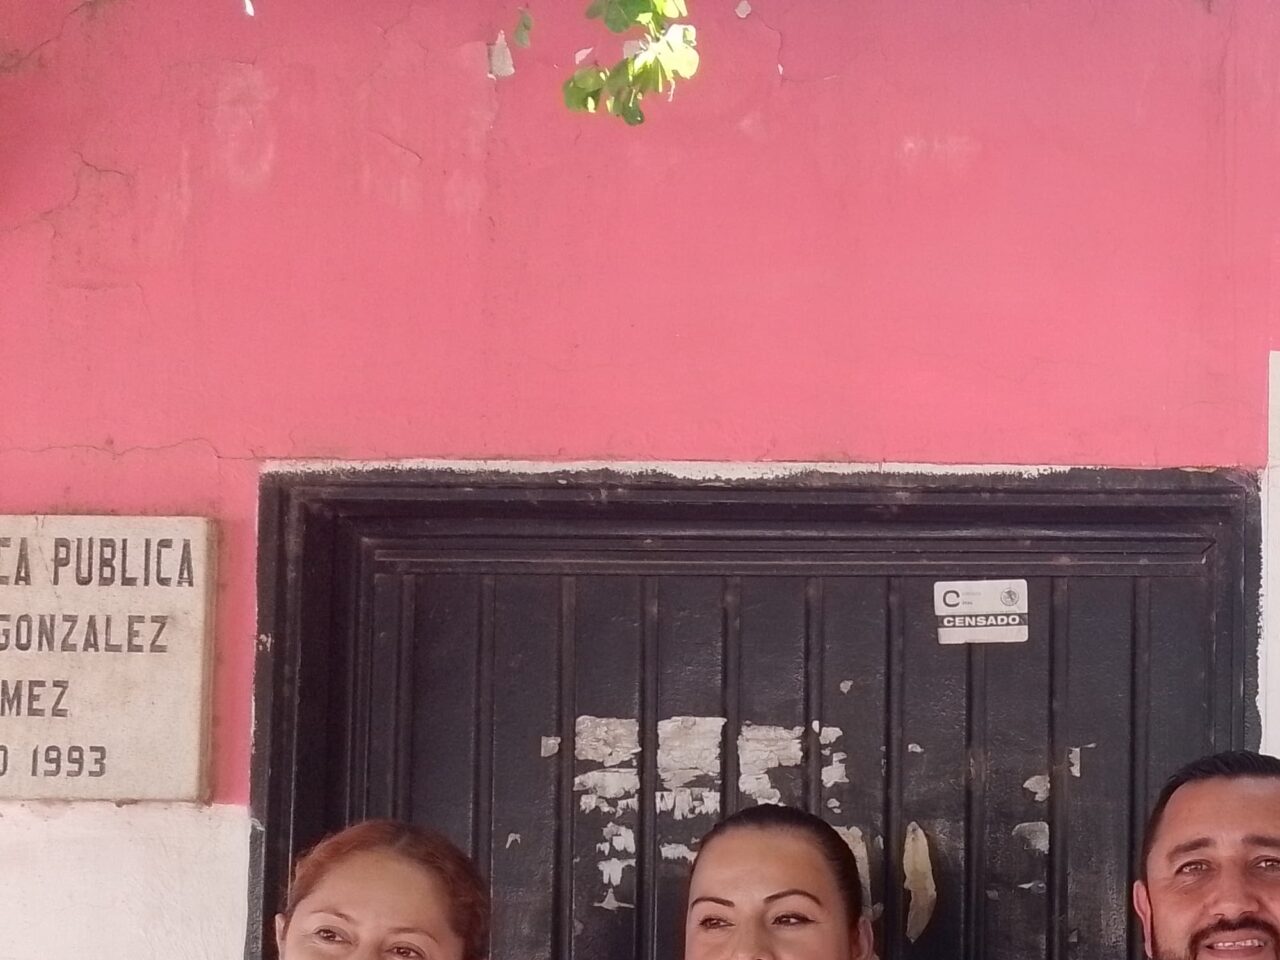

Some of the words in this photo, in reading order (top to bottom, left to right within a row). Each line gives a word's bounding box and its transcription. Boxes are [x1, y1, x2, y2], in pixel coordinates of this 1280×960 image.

[53, 536, 194, 587] PUBLICA
[0, 613, 169, 653] GONZALEZ
[943, 615, 1020, 627] CENSADO
[0, 679, 69, 717] MEZ
[31, 744, 107, 778] 1993
